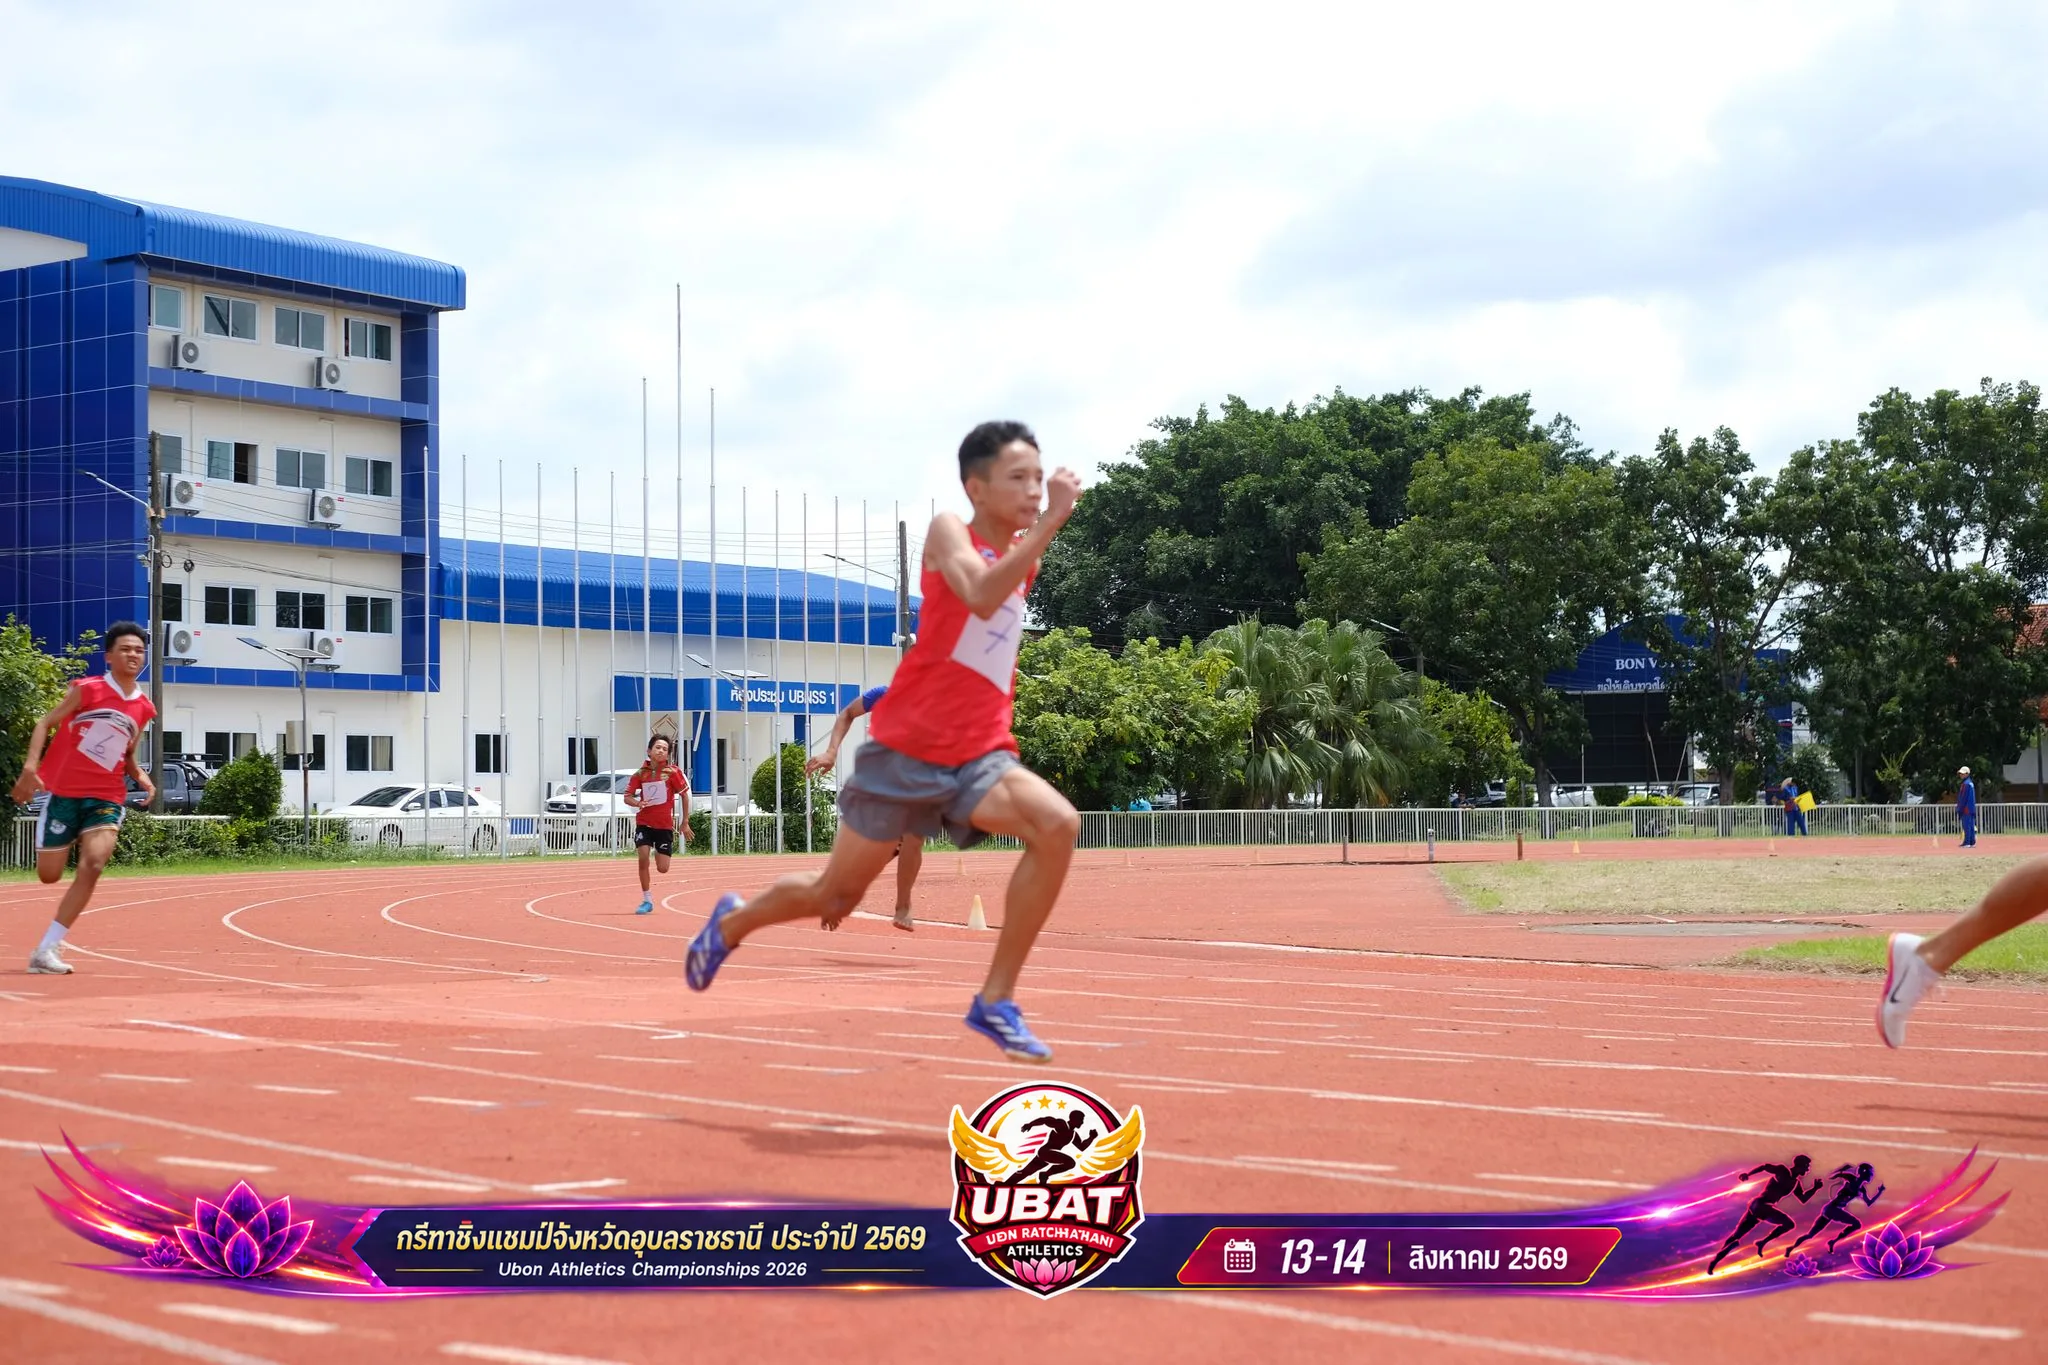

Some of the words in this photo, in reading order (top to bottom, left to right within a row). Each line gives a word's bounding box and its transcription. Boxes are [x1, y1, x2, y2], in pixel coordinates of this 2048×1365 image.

[1615, 658, 1646, 671] BON
[830, 691, 836, 705] 1
[647, 784, 659, 799] 2
